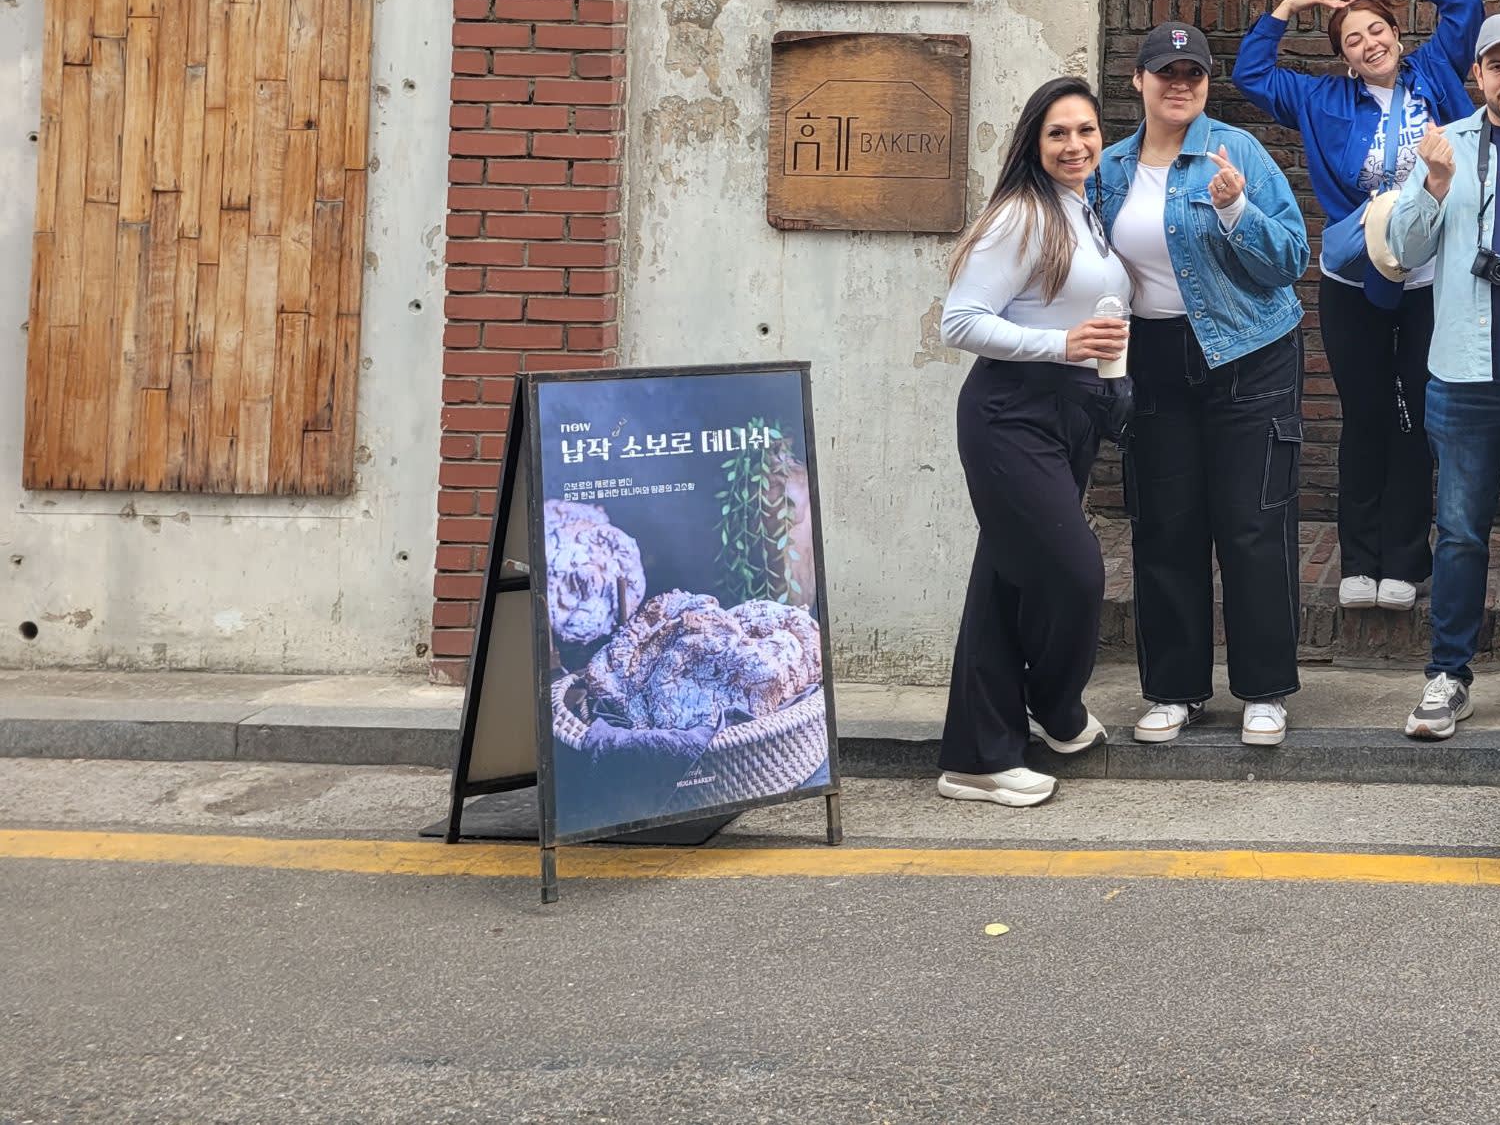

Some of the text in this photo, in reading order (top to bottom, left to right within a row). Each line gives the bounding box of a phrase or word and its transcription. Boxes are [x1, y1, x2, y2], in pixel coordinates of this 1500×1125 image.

[861, 131, 946, 154] BAKERY
[561, 422, 592, 433] new
[561, 426, 770, 465] 납작 소보로 데니쉬
